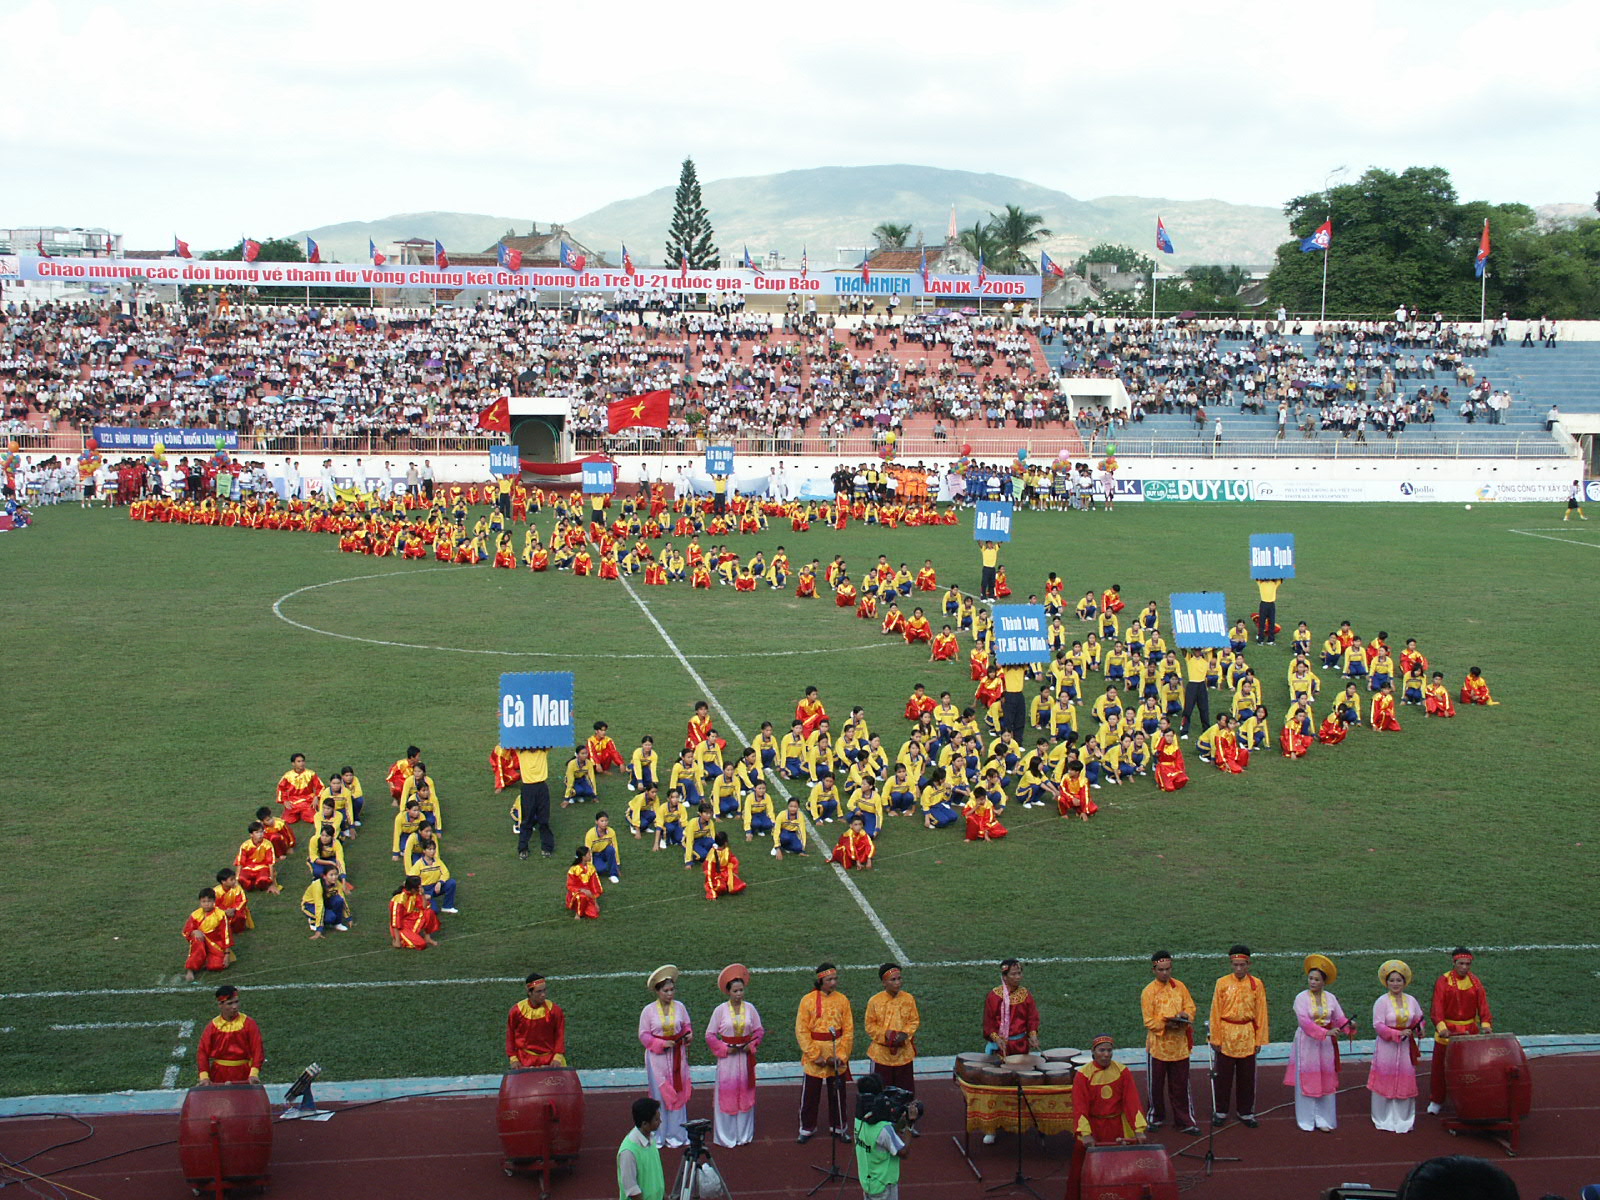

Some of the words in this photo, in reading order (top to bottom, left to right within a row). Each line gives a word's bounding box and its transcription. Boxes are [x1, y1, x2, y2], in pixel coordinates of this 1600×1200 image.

[286, 268, 332, 282] tham
[409, 270, 463, 286] chung
[633, 274, 668, 288] U-21
[716, 277, 742, 290] gia
[955, 281, 971, 294] IX
[982, 281, 1025, 294] 2005
[1178, 480, 1221, 500] DUY
[1022, 615, 1040, 632] Long
[1029, 636, 1047, 651] Minh
[502, 694, 526, 728] Cà
[532, 694, 570, 727] Mau
